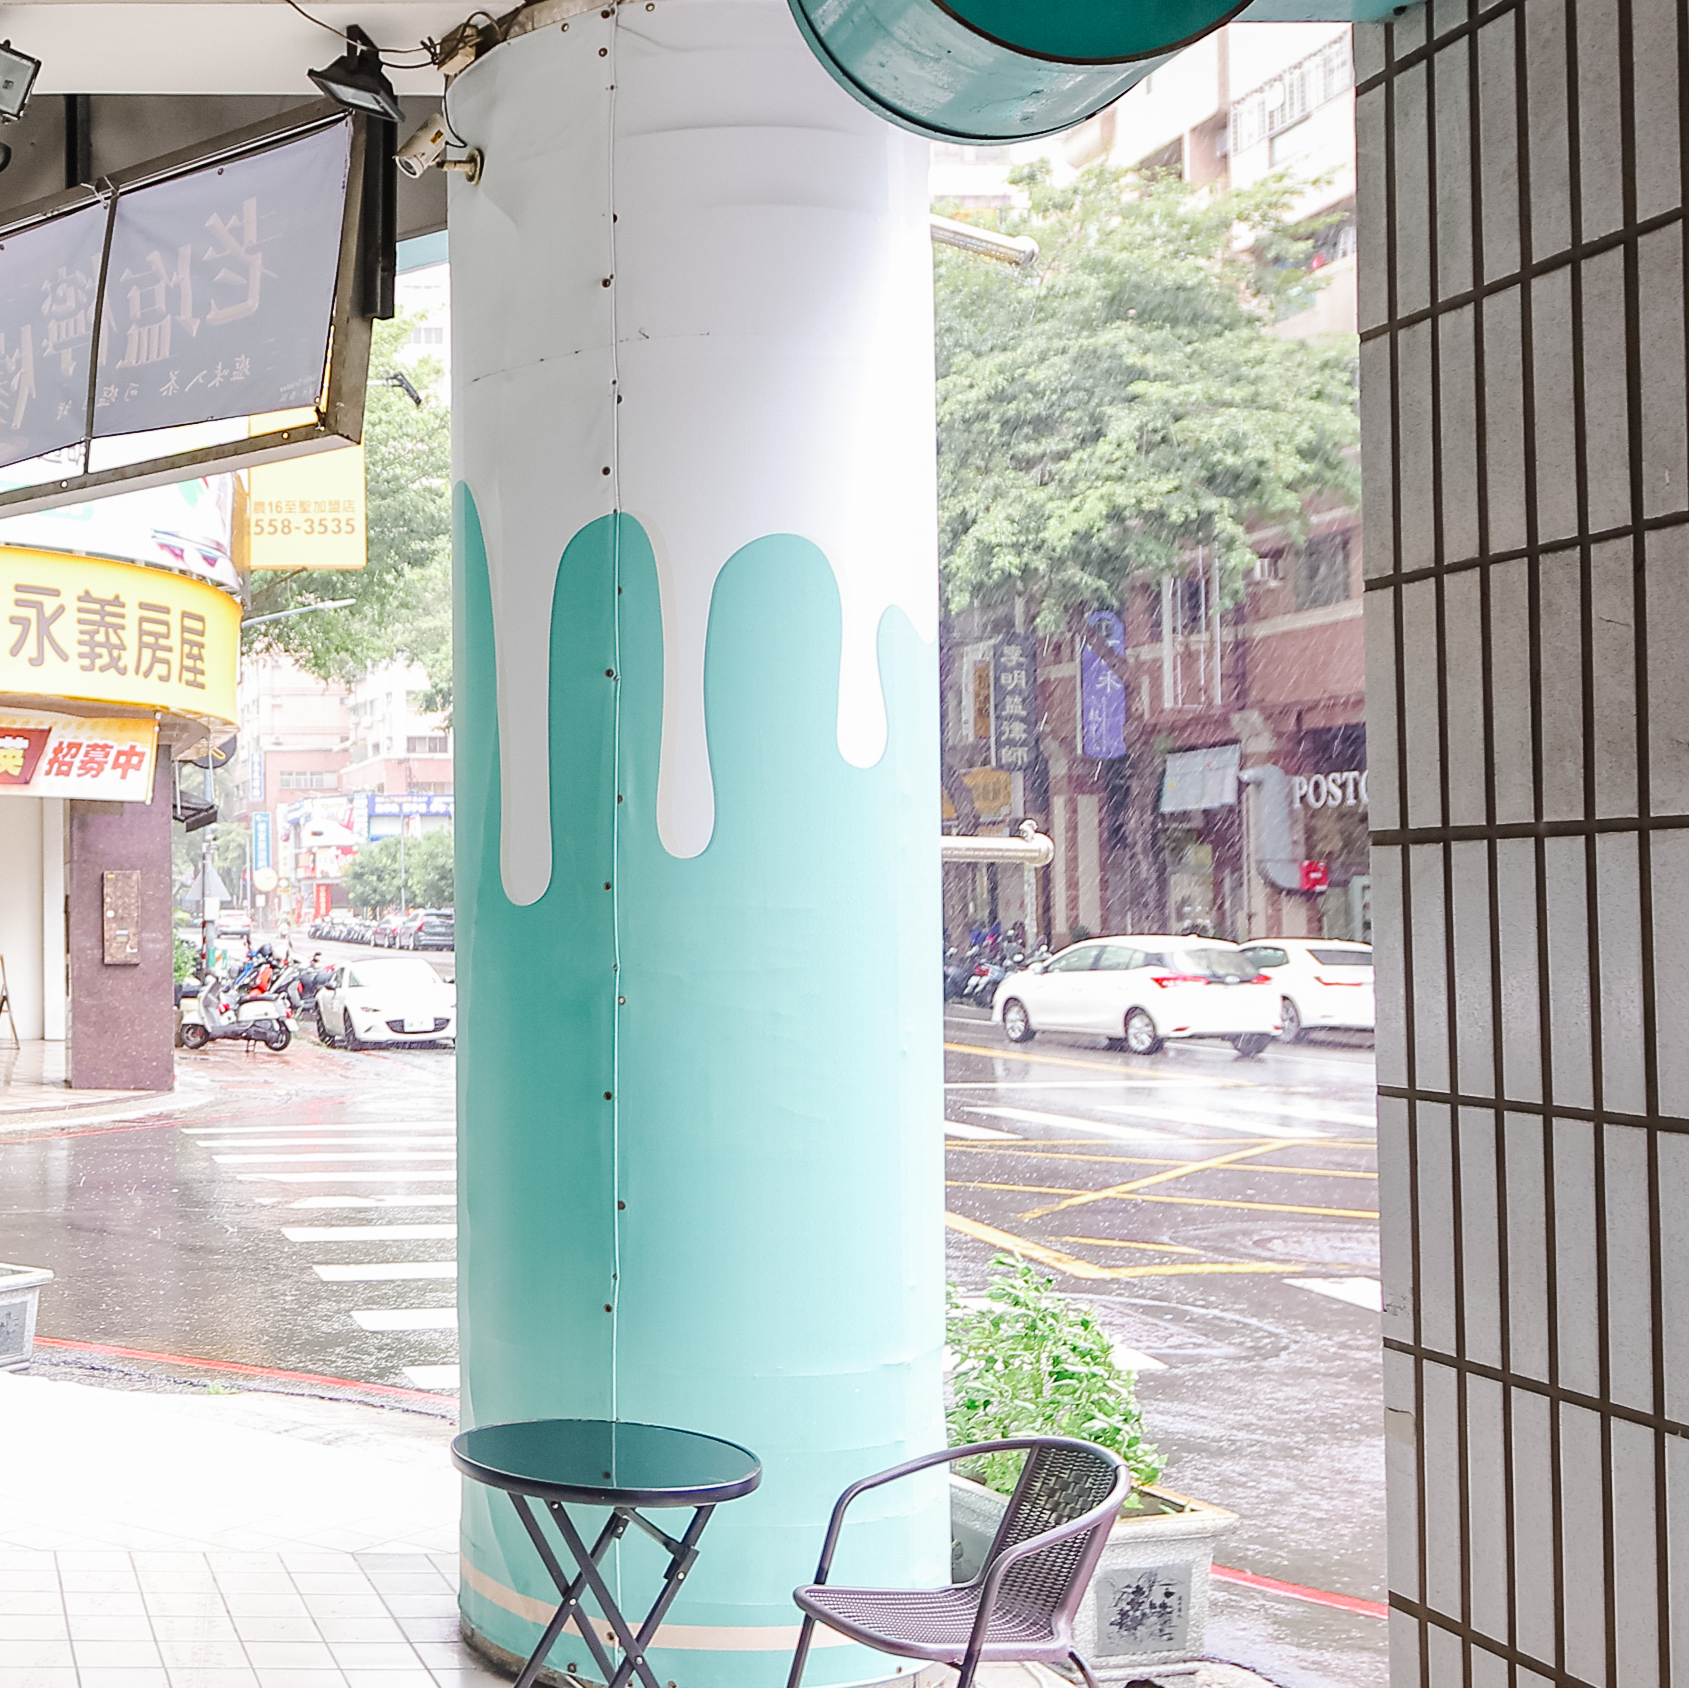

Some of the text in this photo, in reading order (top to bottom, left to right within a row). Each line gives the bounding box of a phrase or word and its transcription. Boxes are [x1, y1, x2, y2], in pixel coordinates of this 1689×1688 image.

[253, 517, 356, 536] 558-3535
[8, 583, 207, 690] 永義房屋
[44, 740, 147, 780] 招募中
